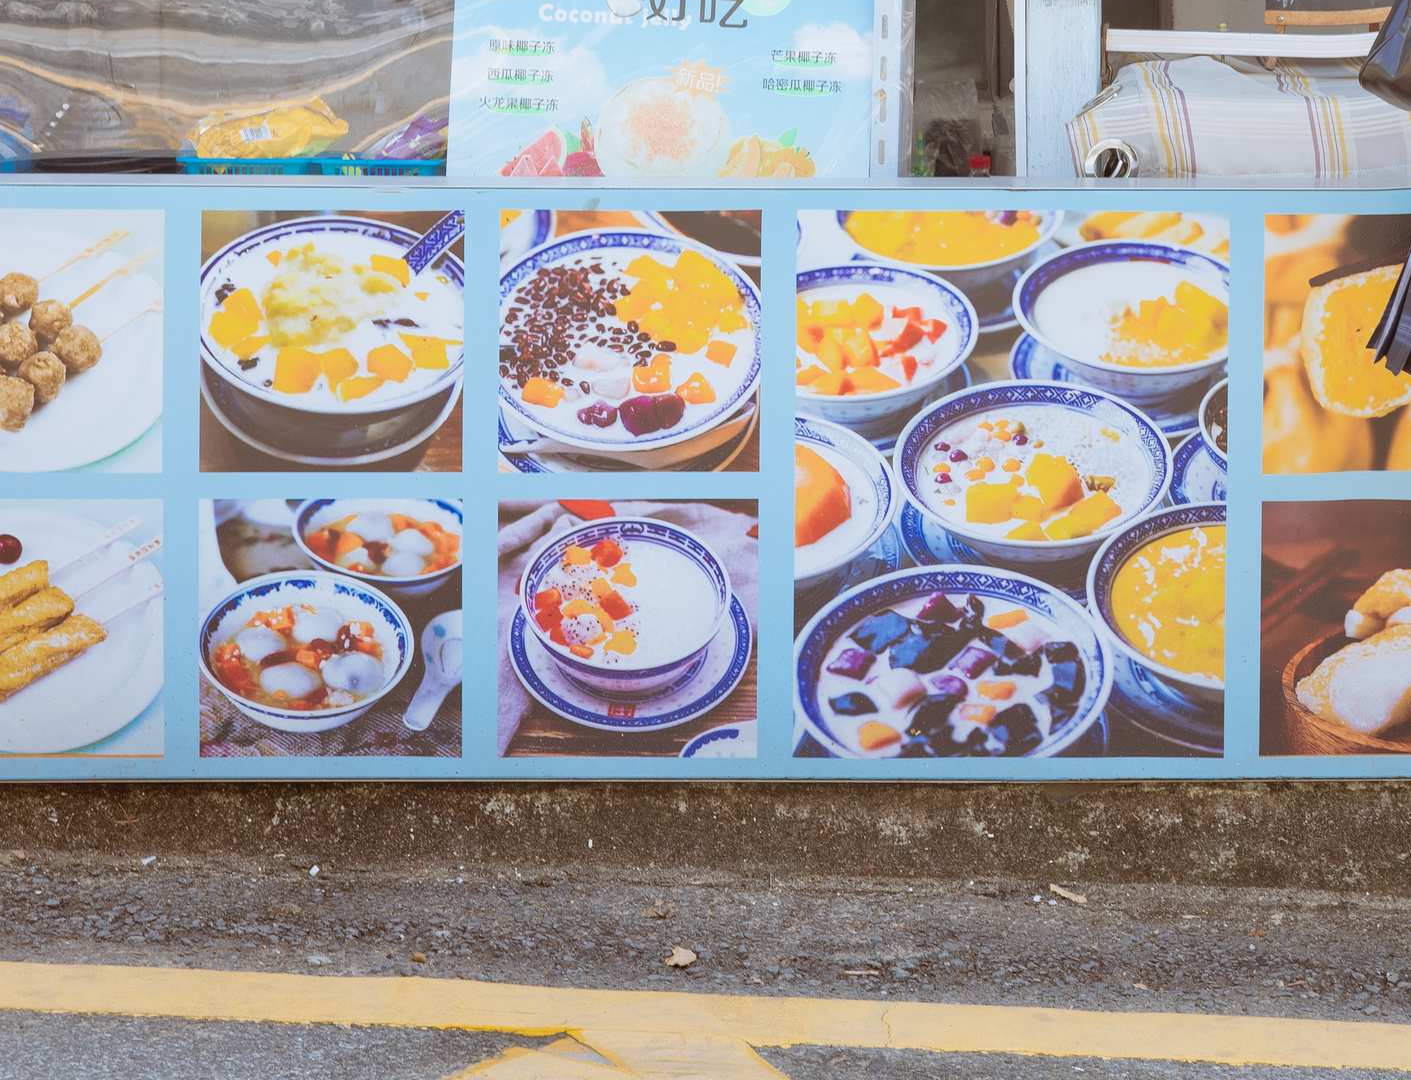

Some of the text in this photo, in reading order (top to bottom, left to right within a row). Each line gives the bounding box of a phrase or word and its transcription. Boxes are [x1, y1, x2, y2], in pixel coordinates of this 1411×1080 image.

[488, 38, 556, 54] 原味椰子冻
[769, 49, 838, 64] 芒果椰子冻
[488, 68, 554, 83] 西瓜椰子冻
[762, 77, 843, 93] 哈密瓜椰子冻
